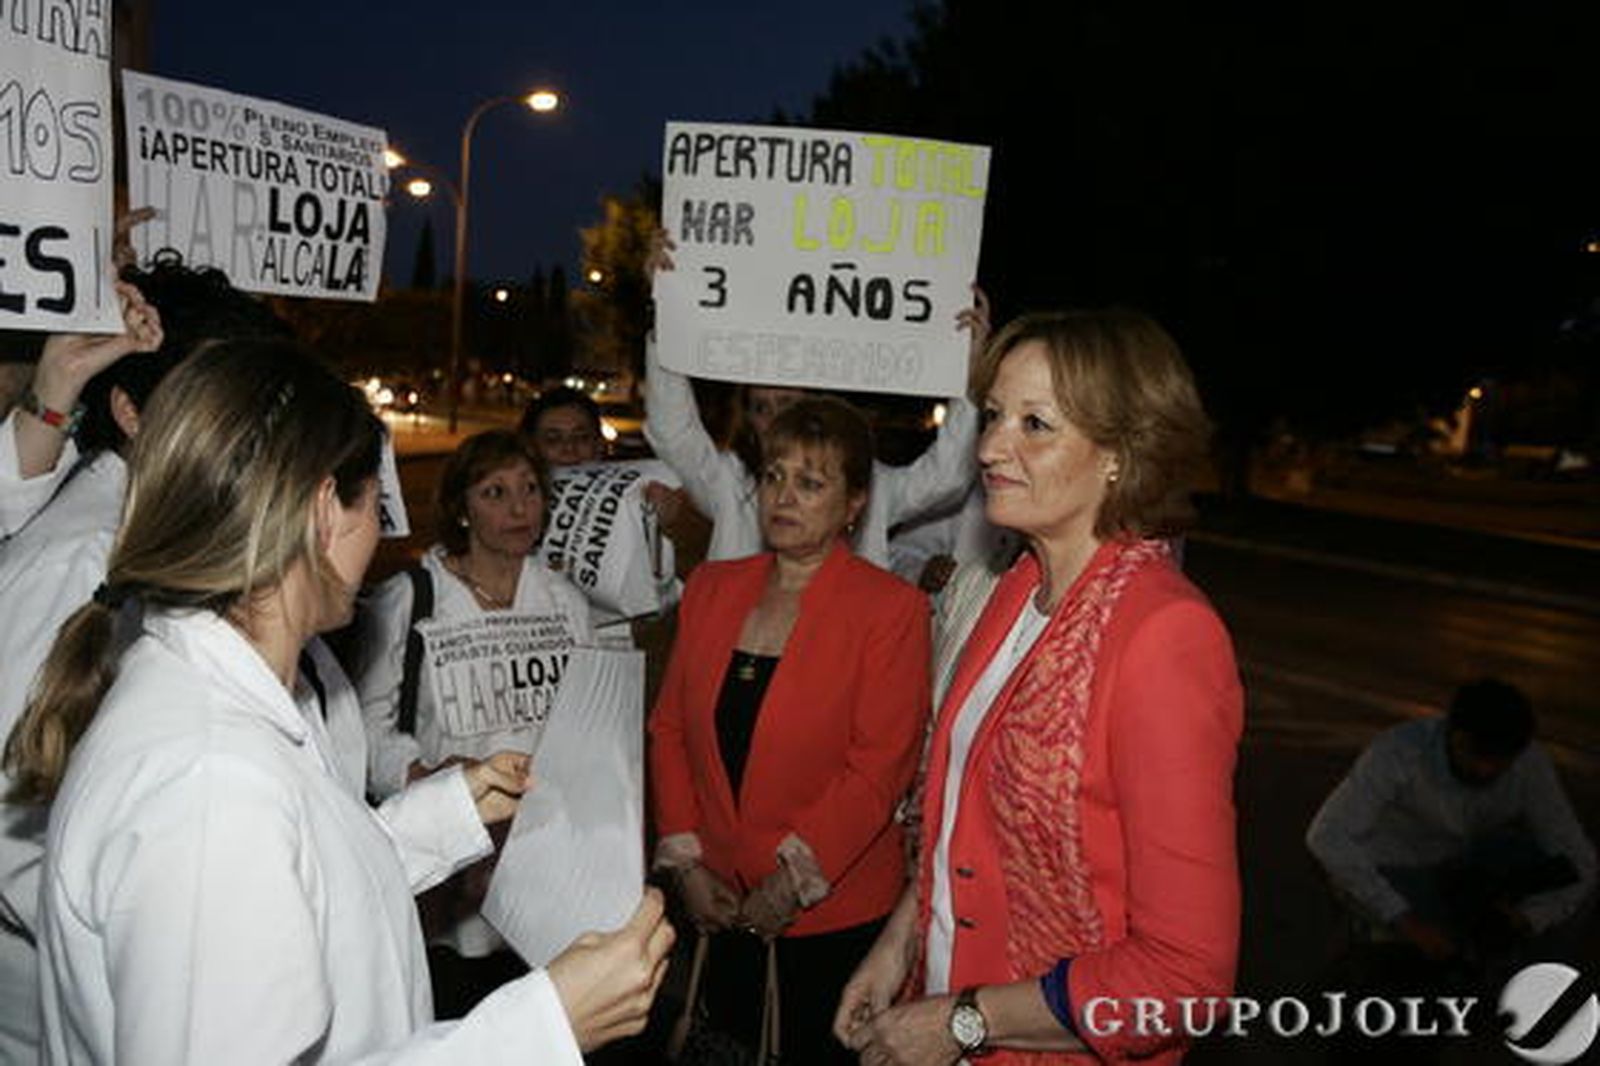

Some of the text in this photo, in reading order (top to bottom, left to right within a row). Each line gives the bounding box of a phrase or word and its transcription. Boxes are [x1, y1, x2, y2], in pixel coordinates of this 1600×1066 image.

[137, 88, 247, 140] 100%
[243, 107, 308, 137] PLENO
[667, 132, 985, 199] APERTURA TOTAL
[268, 187, 370, 245] LOJA
[793, 192, 948, 258] LOJA
[698, 262, 933, 323] 3 AÑOS
[578, 470, 641, 588] SANIDAD
